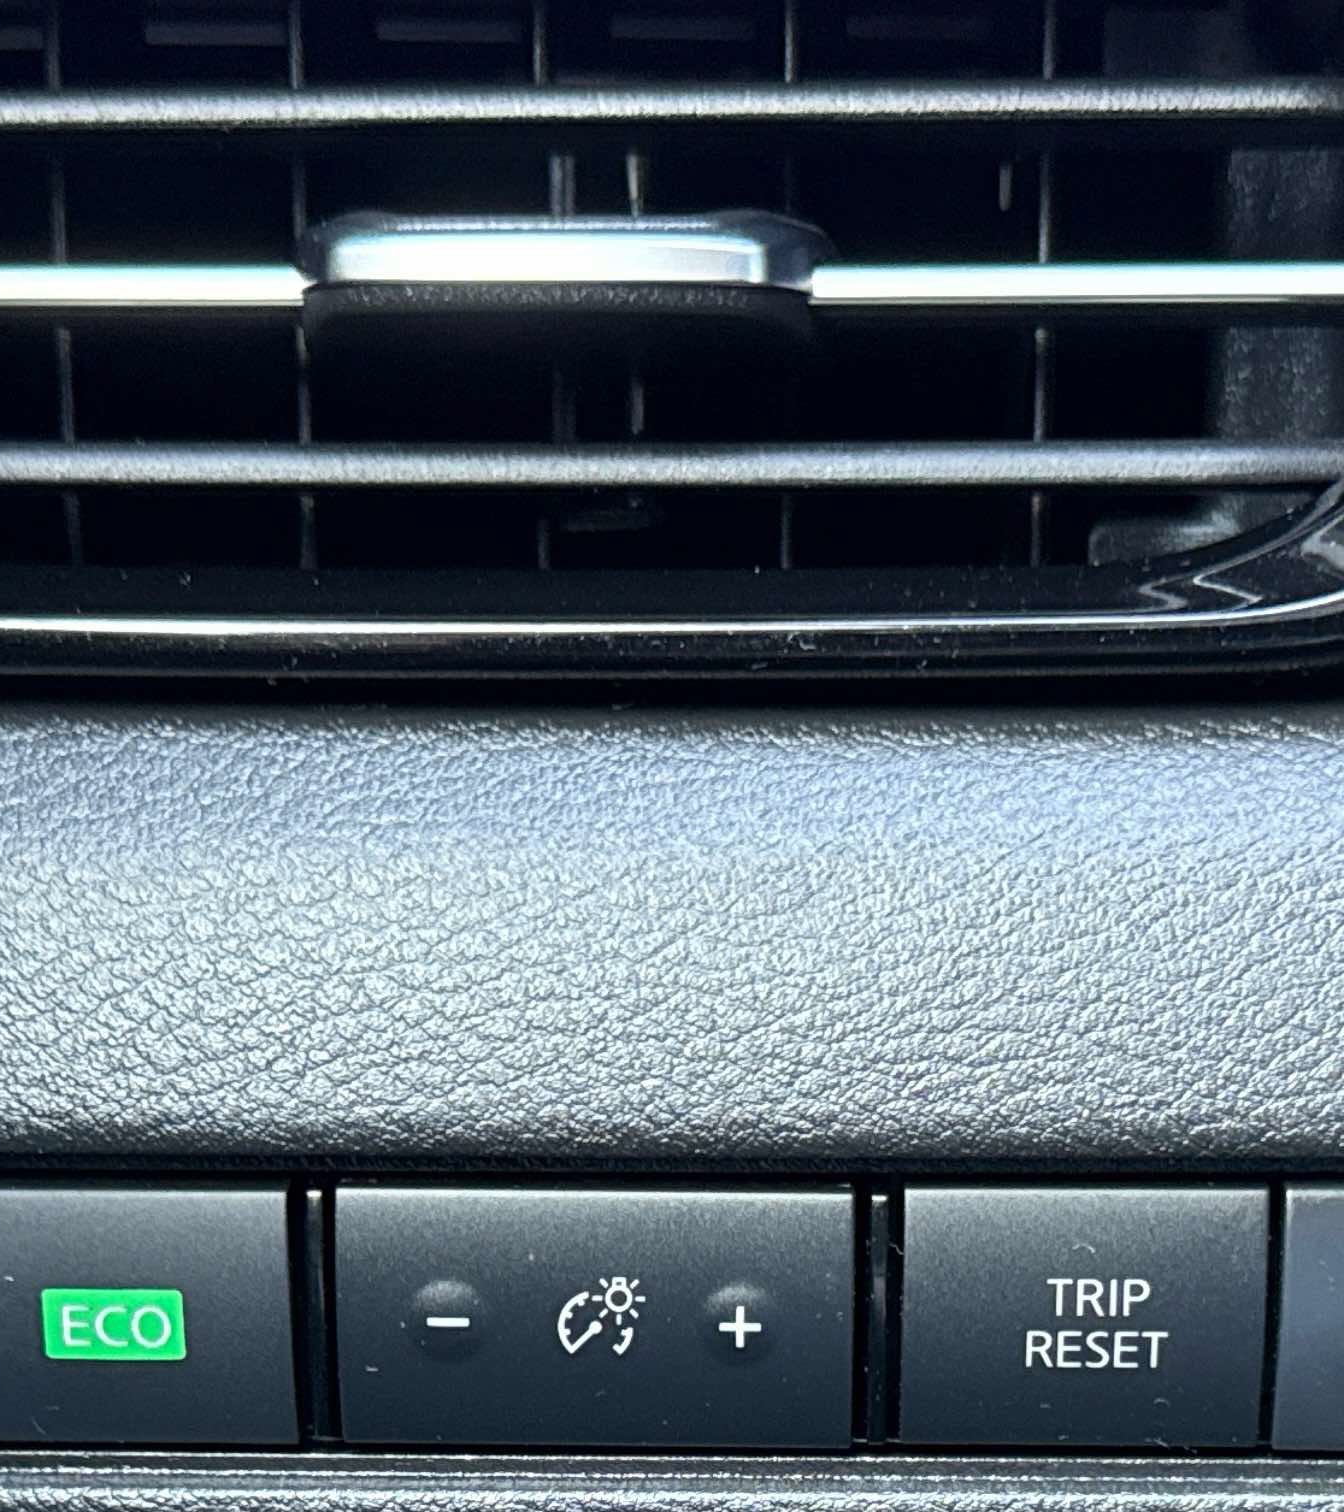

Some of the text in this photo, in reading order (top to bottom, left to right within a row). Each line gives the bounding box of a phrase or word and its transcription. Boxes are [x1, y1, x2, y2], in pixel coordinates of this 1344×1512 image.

[1046, 1278, 1151, 1317] TRIP
[61, 1304, 172, 1349] ECO
[1025, 1330, 1169, 1369] RESET
